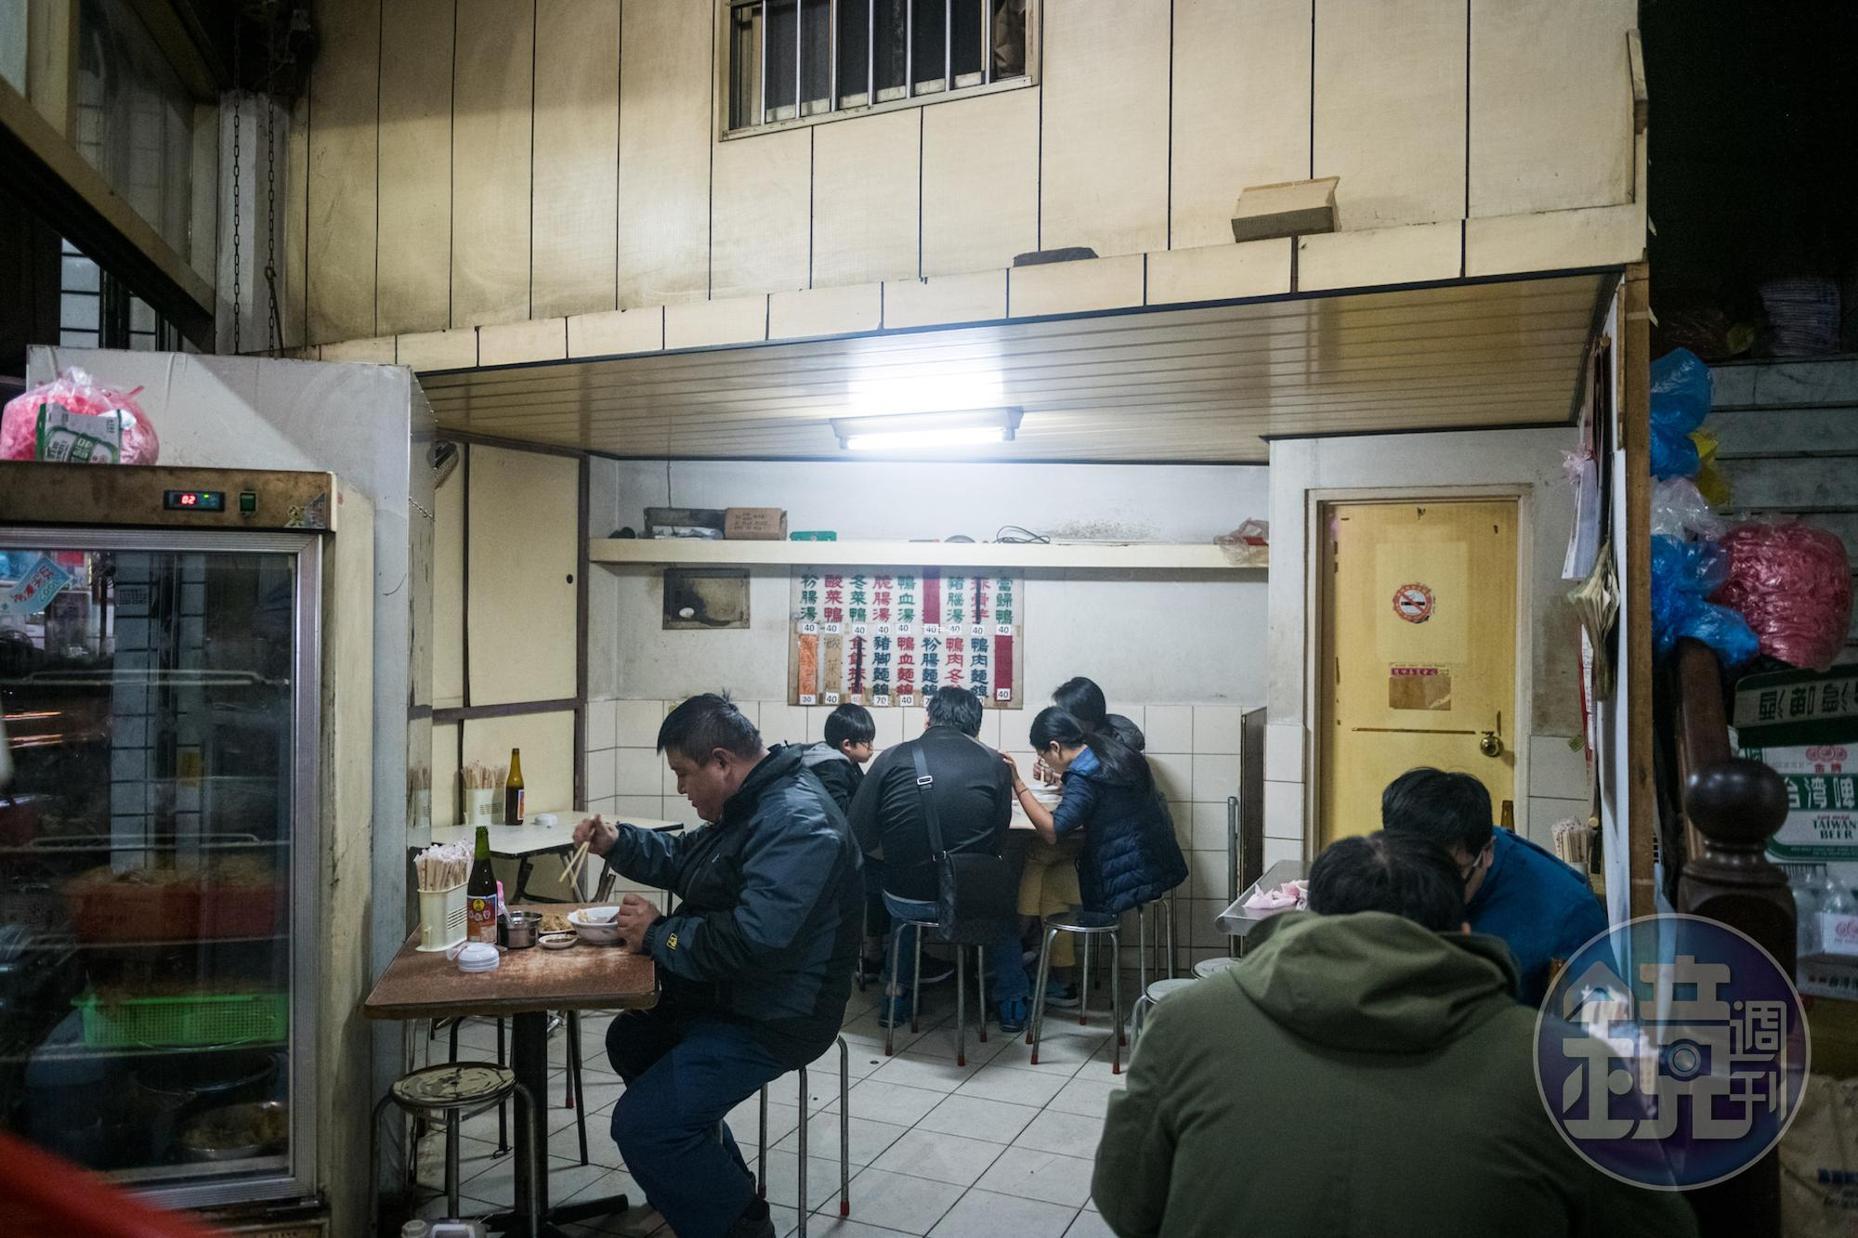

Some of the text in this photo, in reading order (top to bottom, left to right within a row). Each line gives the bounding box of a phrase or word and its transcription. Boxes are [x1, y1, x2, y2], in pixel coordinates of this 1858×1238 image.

[824, 574, 844, 623] 酸菜鴨
[849, 574, 867, 623] 冬菜鴨
[897, 575, 915, 623] 鴨血湯
[944, 637, 965, 688] 鴨肉冬
[826, 695, 837, 703] 40
[1760, 681, 1858, 720] 灣啤酒
[1813, 820, 1857, 830] TAIWAN
[1820, 830, 1853, 840] BEER
